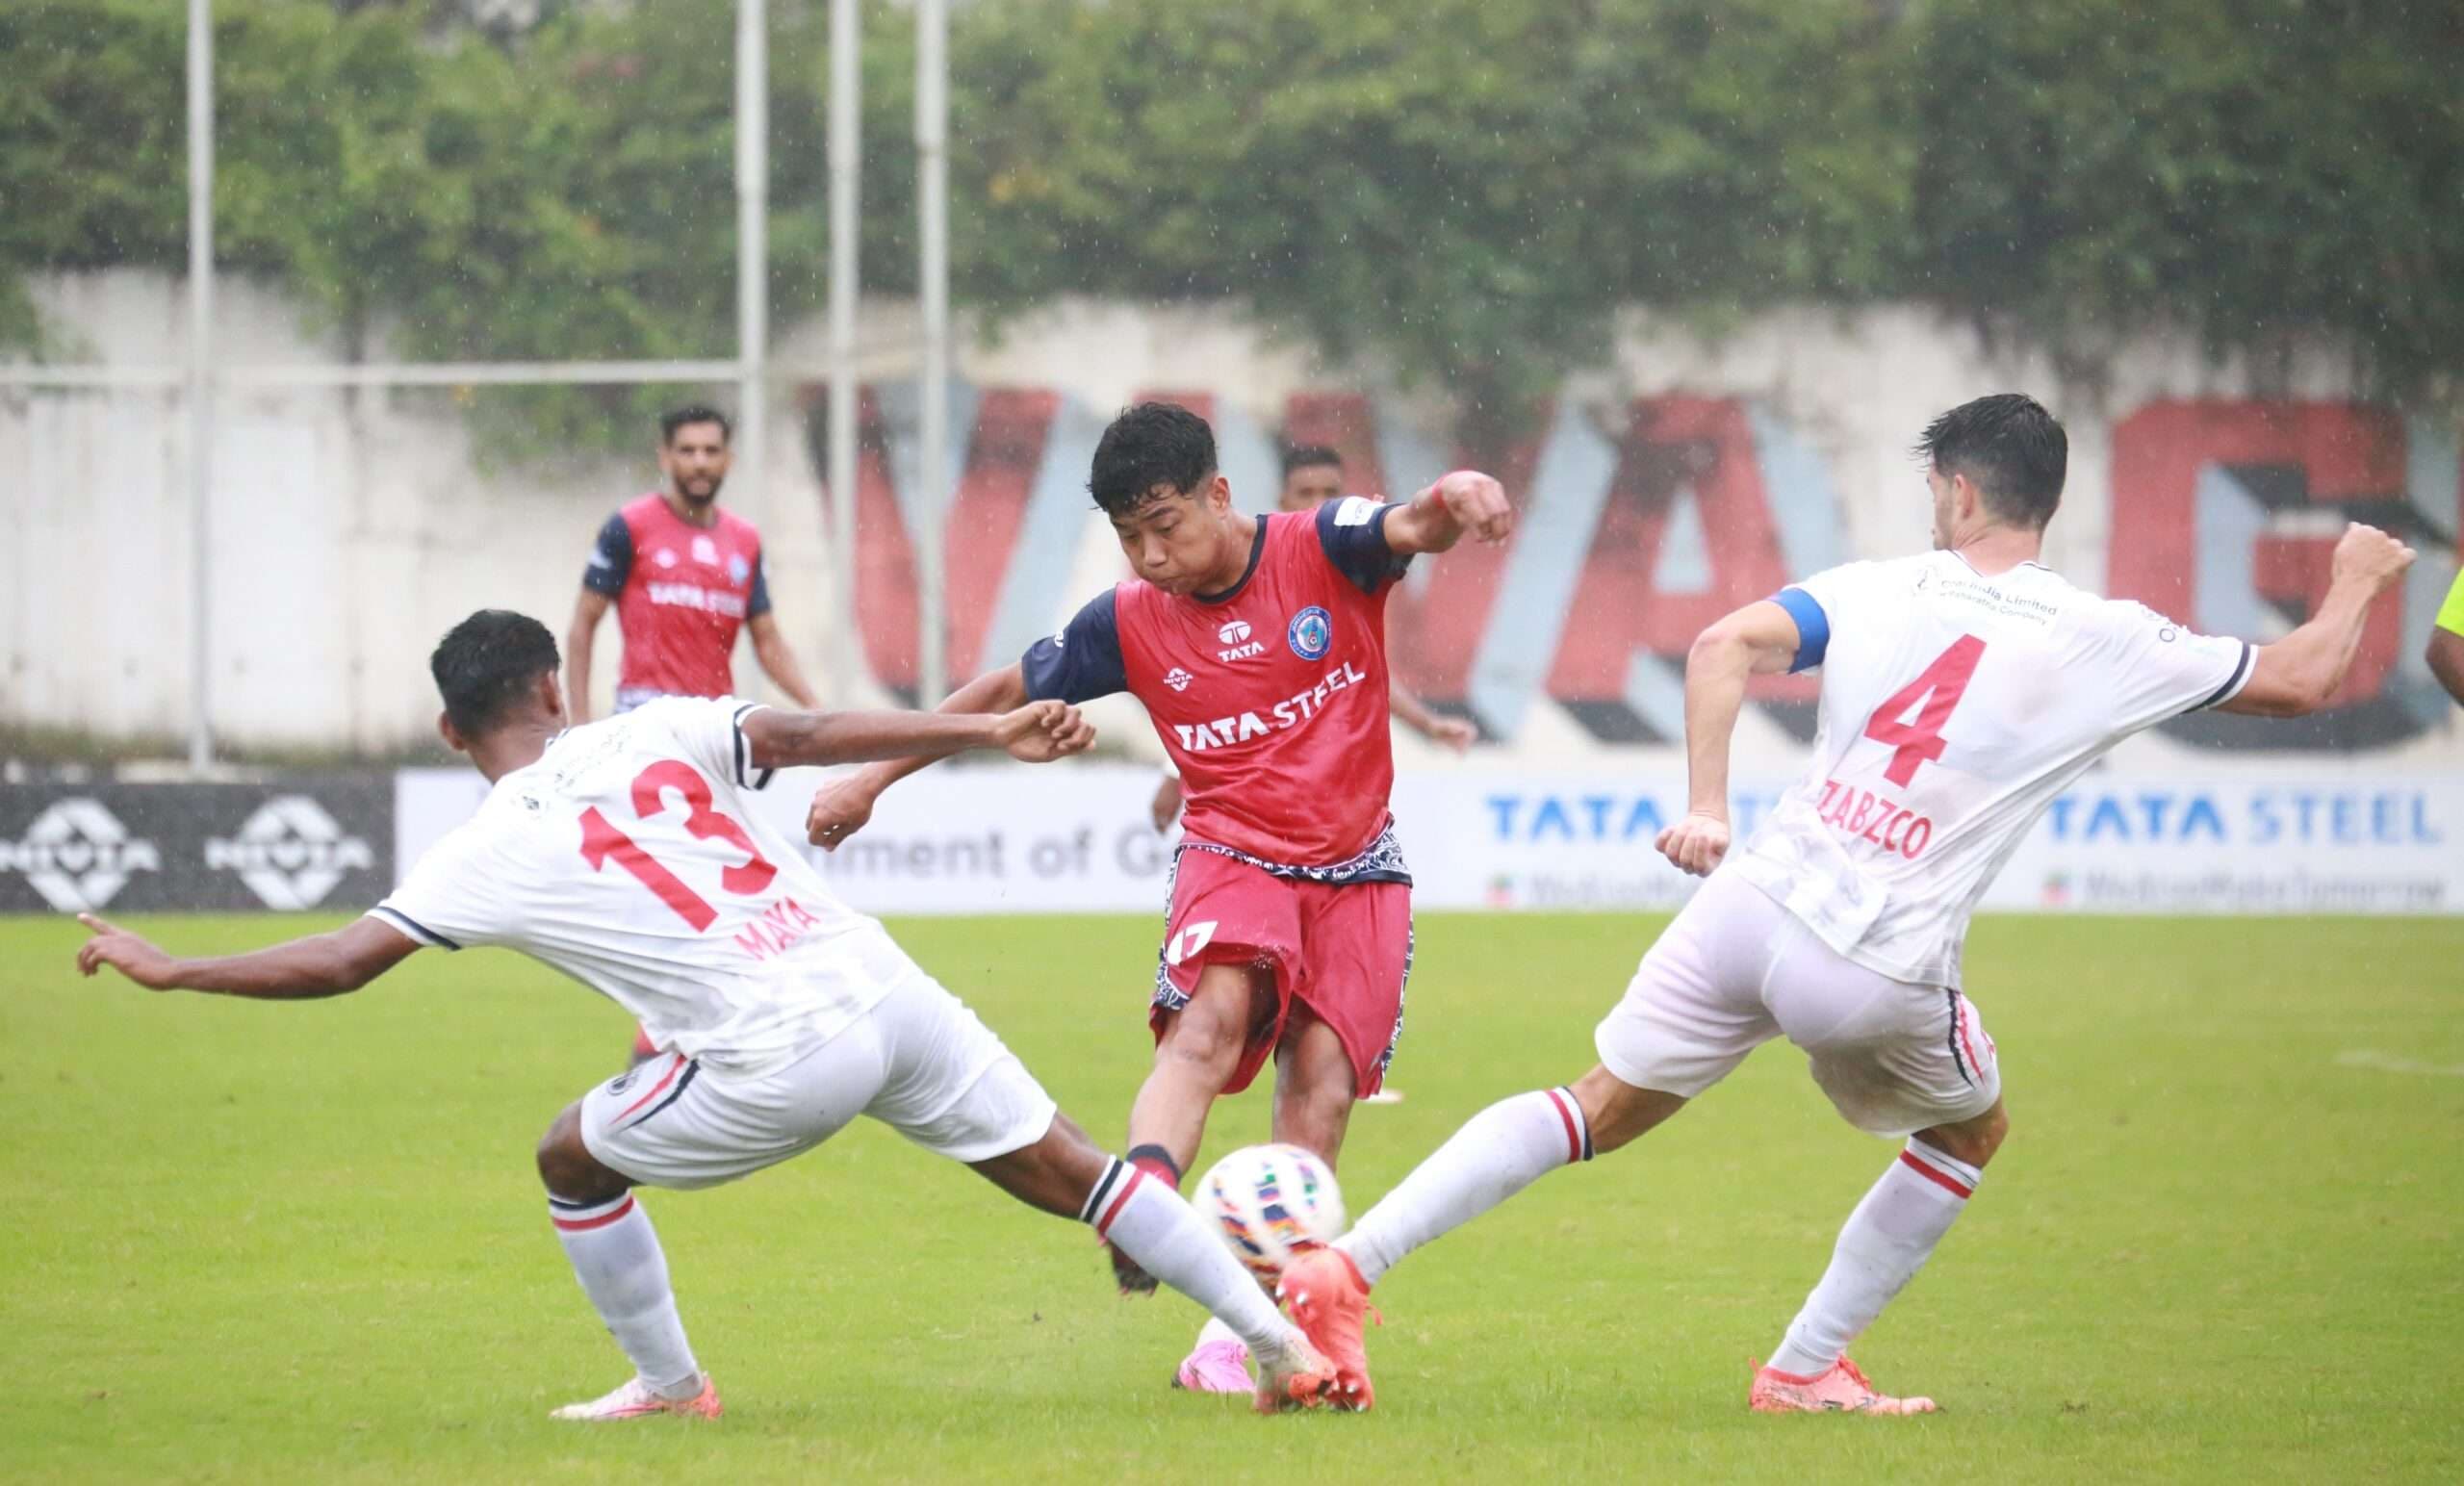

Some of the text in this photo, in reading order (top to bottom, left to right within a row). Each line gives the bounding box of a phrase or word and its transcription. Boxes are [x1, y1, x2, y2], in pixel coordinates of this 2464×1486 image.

[820, 388, 1834, 743] VVA
[1217, 641, 1265, 663] TATA
[1174, 661, 1367, 752] TATA STEEL
[1863, 633, 1987, 789] 4
[578, 759, 779, 935] 13
[1028, 822, 1094, 878] of
[1485, 793, 1665, 841] TATA
[2048, 791, 2442, 845] TATA STEEL
